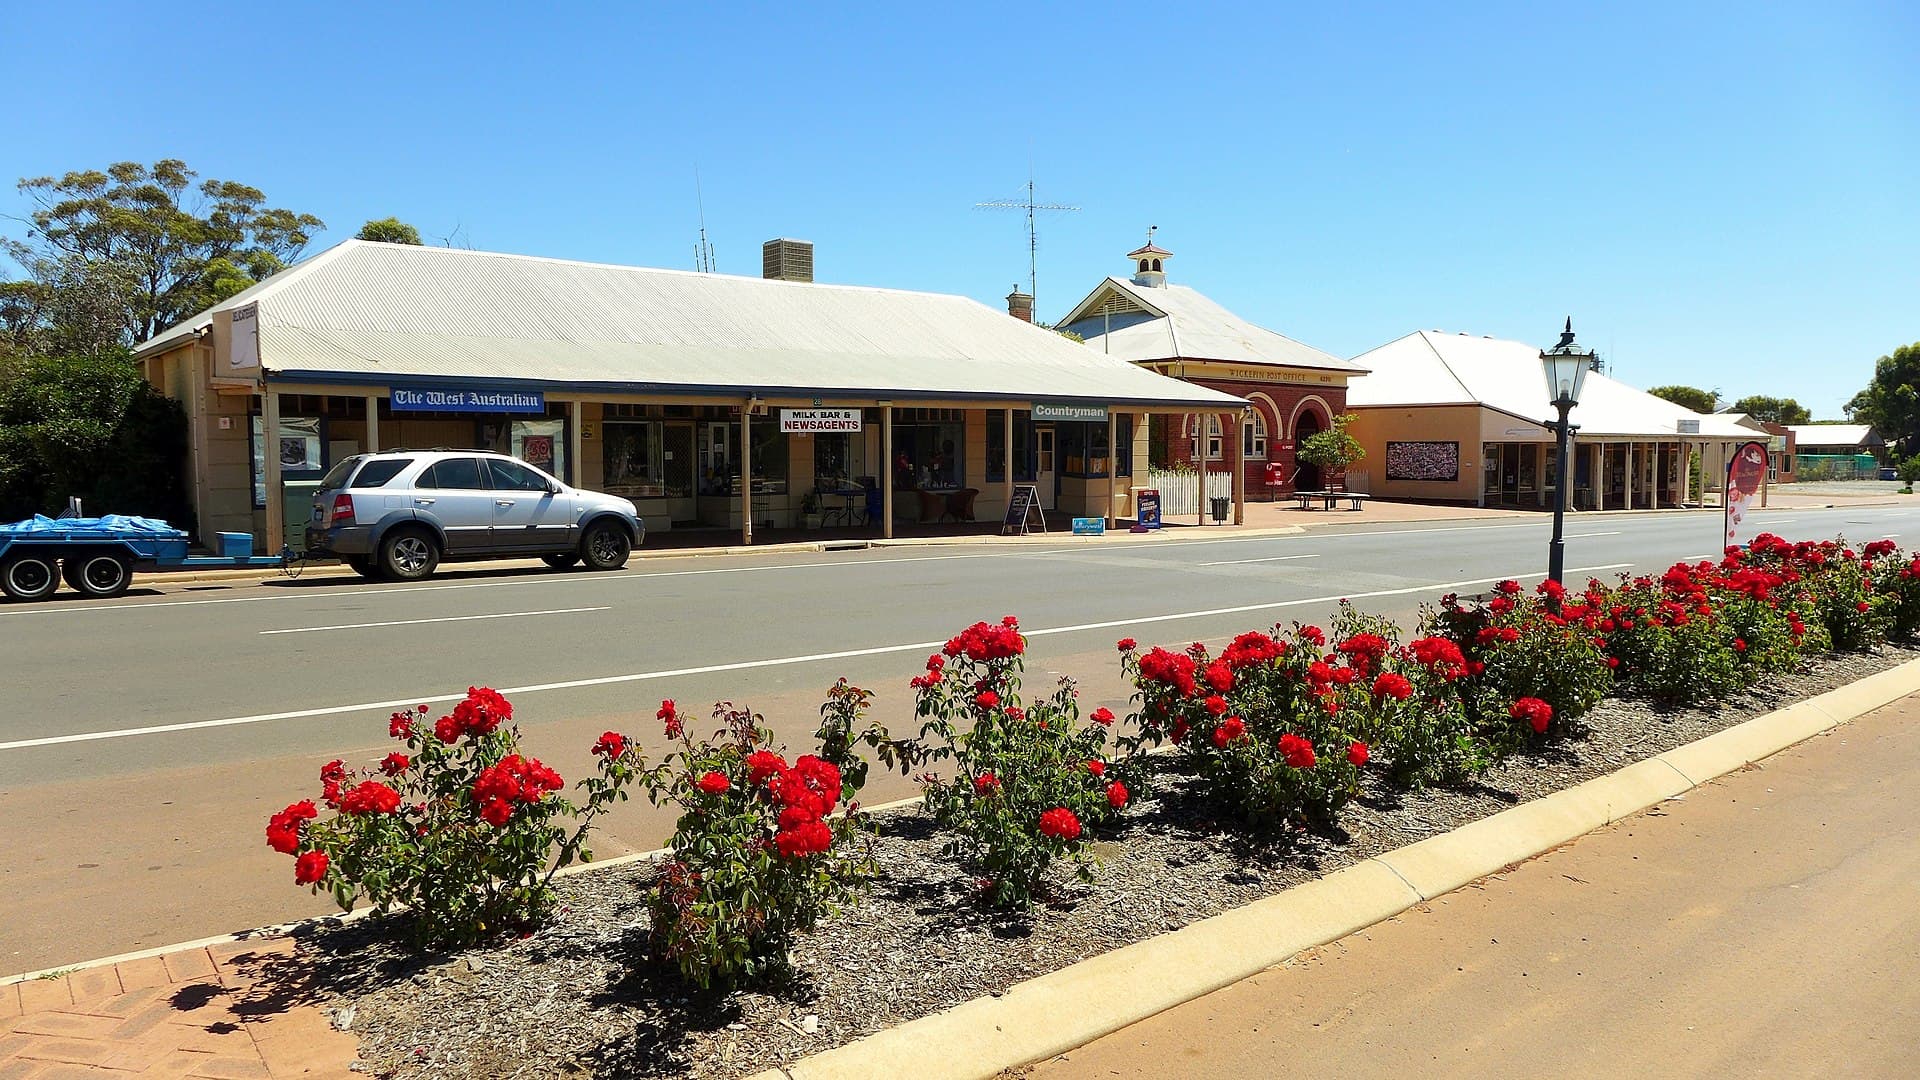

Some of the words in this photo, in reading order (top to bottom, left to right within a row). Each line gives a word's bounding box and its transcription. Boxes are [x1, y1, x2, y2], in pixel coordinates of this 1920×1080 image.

[1266, 371, 1280, 380] POST
[1283, 372, 1306, 381] OFFICE
[394, 390, 423, 405] The
[426, 391, 465, 406] West
[468, 392, 538, 407] Australian
[792, 411, 817, 419] MILK
[820, 411, 841, 419] BAR
[843, 411, 851, 419] &
[1035, 404, 1105, 418] Countryman
[784, 420, 859, 430] NEWSAGENTS
